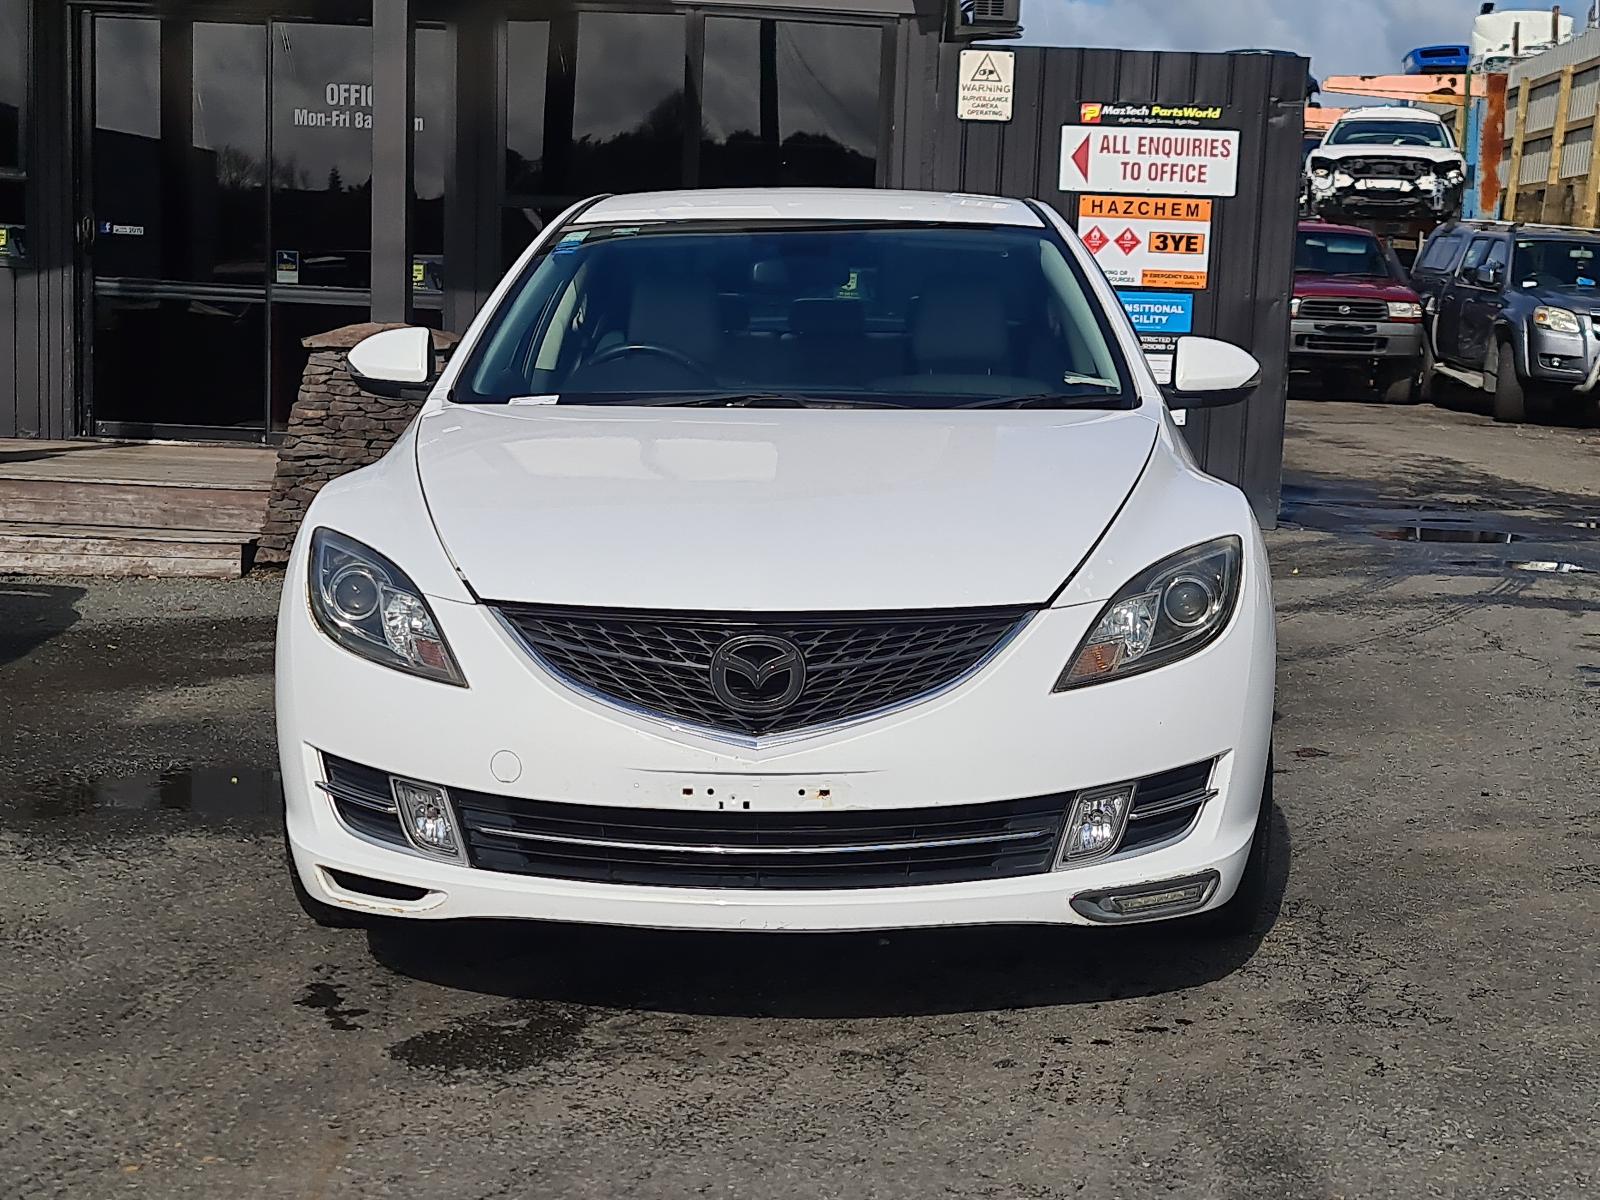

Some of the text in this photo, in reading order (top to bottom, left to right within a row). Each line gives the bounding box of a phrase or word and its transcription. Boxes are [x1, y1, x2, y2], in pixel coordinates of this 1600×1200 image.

[961, 83, 1011, 93] WARNING
[294, 108, 351, 127] Mon-Fri
[1151, 106, 1222, 119] PartsWorld
[1099, 134, 1232, 159] ALL ENQUIRIES
[1121, 162, 1208, 184] TO OFFICE
[1091, 199, 1200, 217] HAZCHEM
[1154, 234, 1198, 252] 3YE
[1125, 303, 1185, 314] NSITIONAL
[1131, 315, 1169, 324] CILITY
